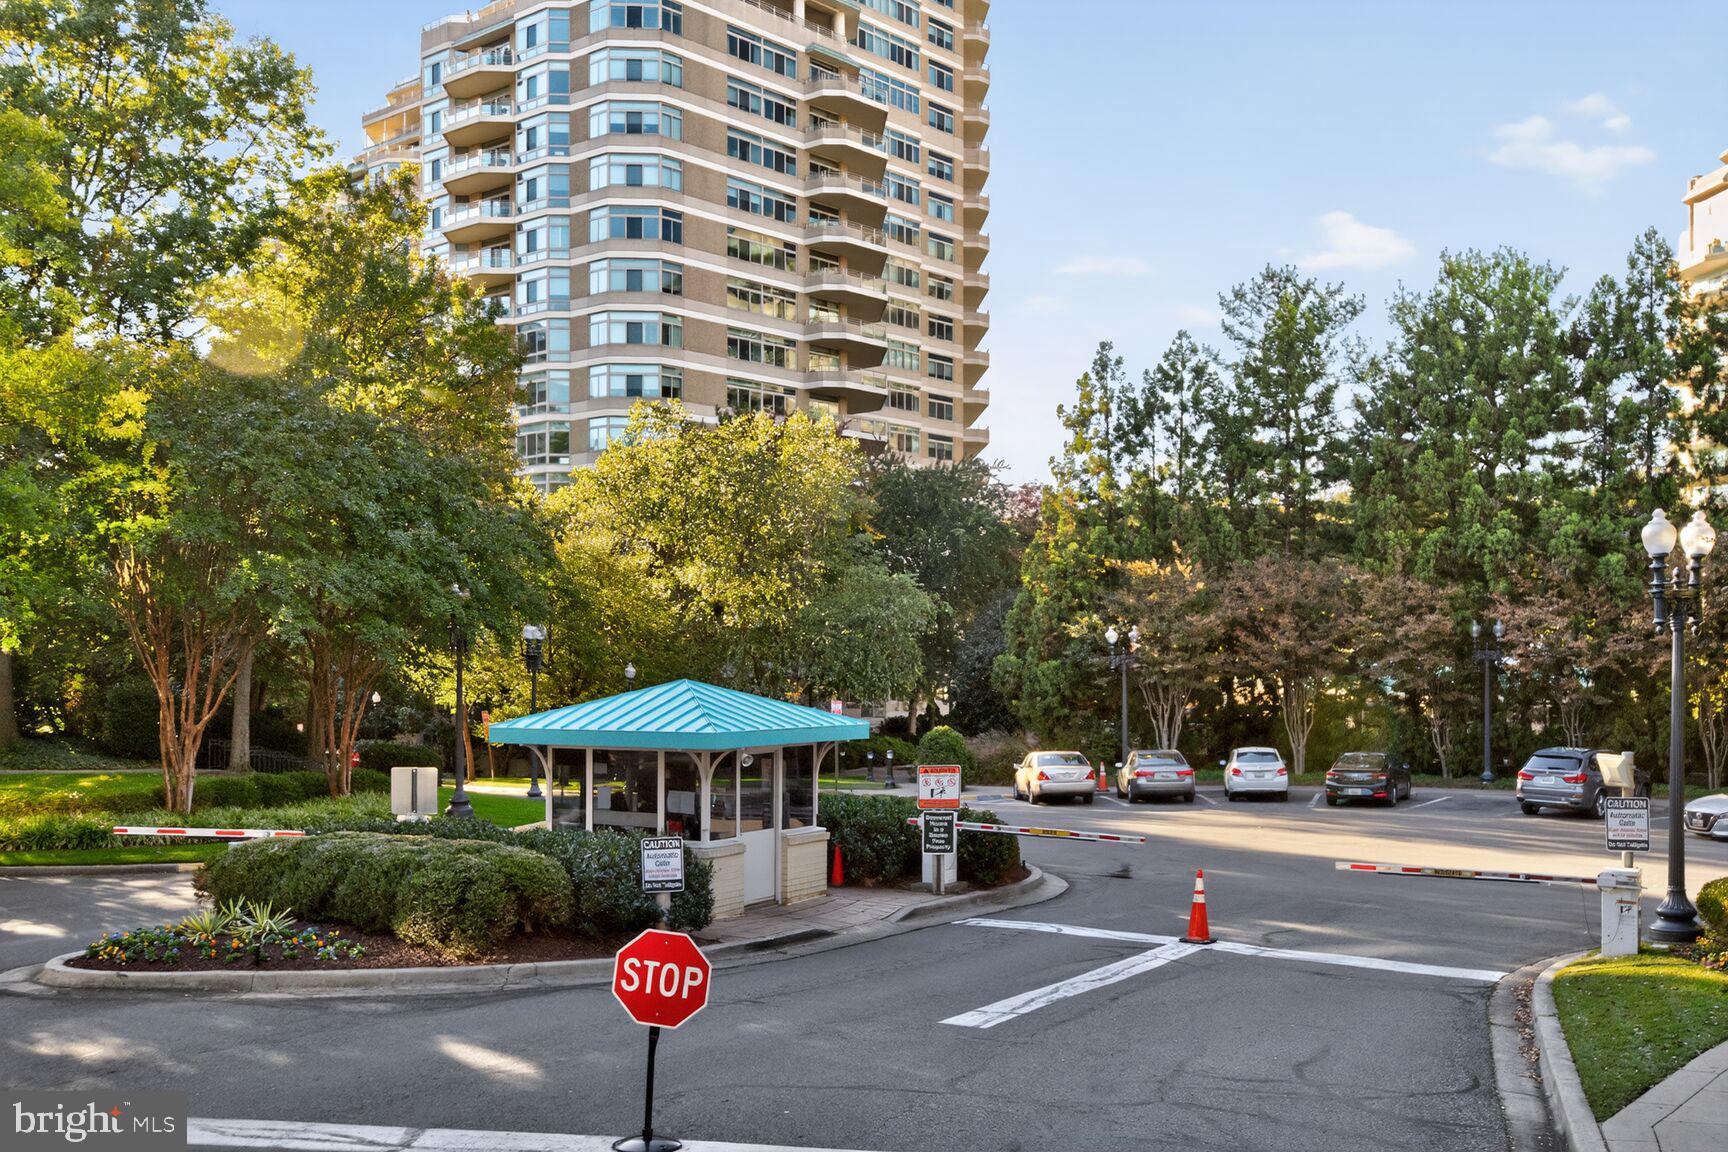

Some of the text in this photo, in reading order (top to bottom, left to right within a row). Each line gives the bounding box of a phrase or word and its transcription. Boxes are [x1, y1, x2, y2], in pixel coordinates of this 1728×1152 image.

[1607, 800, 1647, 808] CAUTION
[643, 840, 680, 849] CAUTION
[620, 957, 704, 999] STOP
